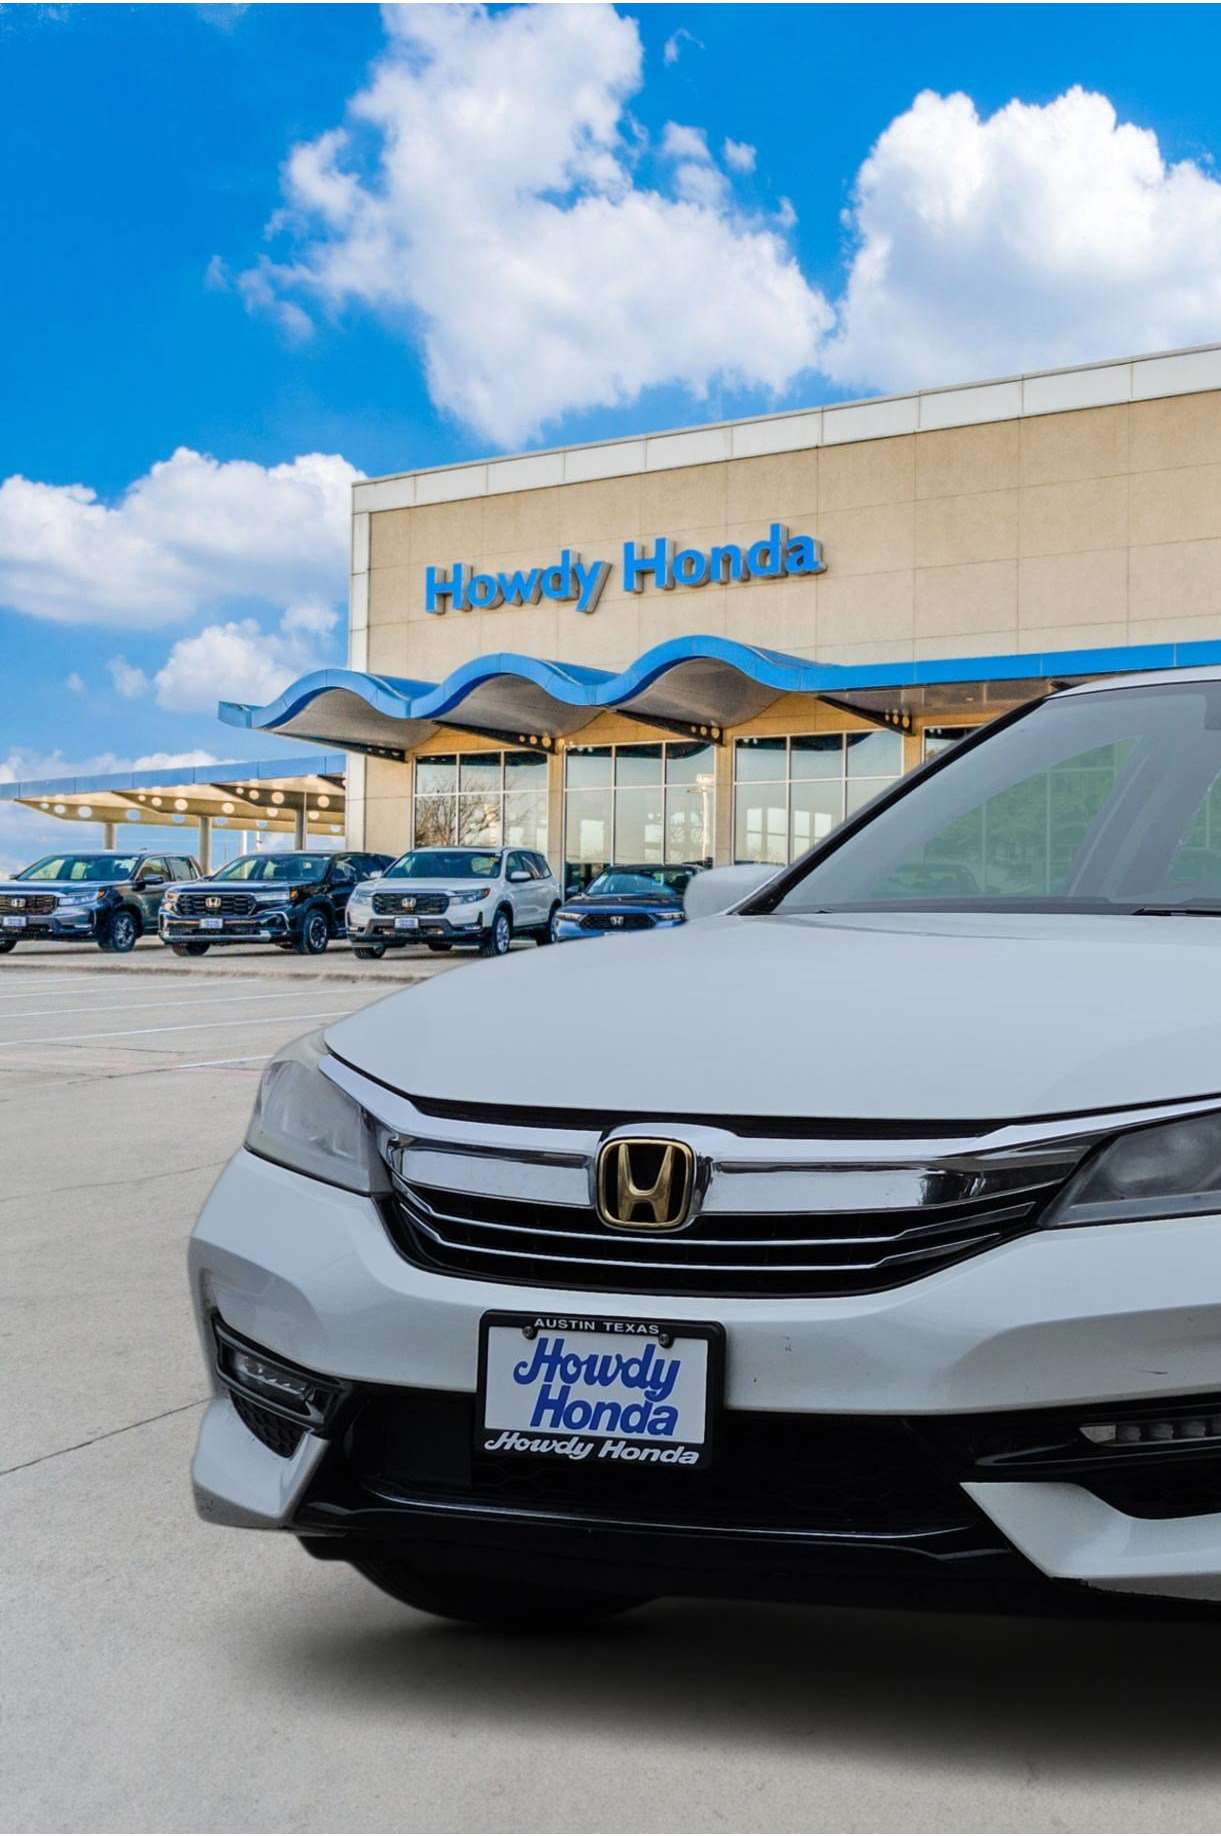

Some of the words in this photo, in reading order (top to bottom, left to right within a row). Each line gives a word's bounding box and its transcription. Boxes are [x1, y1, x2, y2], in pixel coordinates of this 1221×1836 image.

[425, 548, 612, 615] Howdy
[623, 523, 827, 594] Honda
[534, 1318, 596, 1331] AUSTIN
[603, 1322, 660, 1335] TEXAS
[513, 1337, 681, 1401] Howdy
[530, 1384, 679, 1436] Honda
[484, 1431, 594, 1460] Howdy
[598, 1440, 699, 1465] Honda
